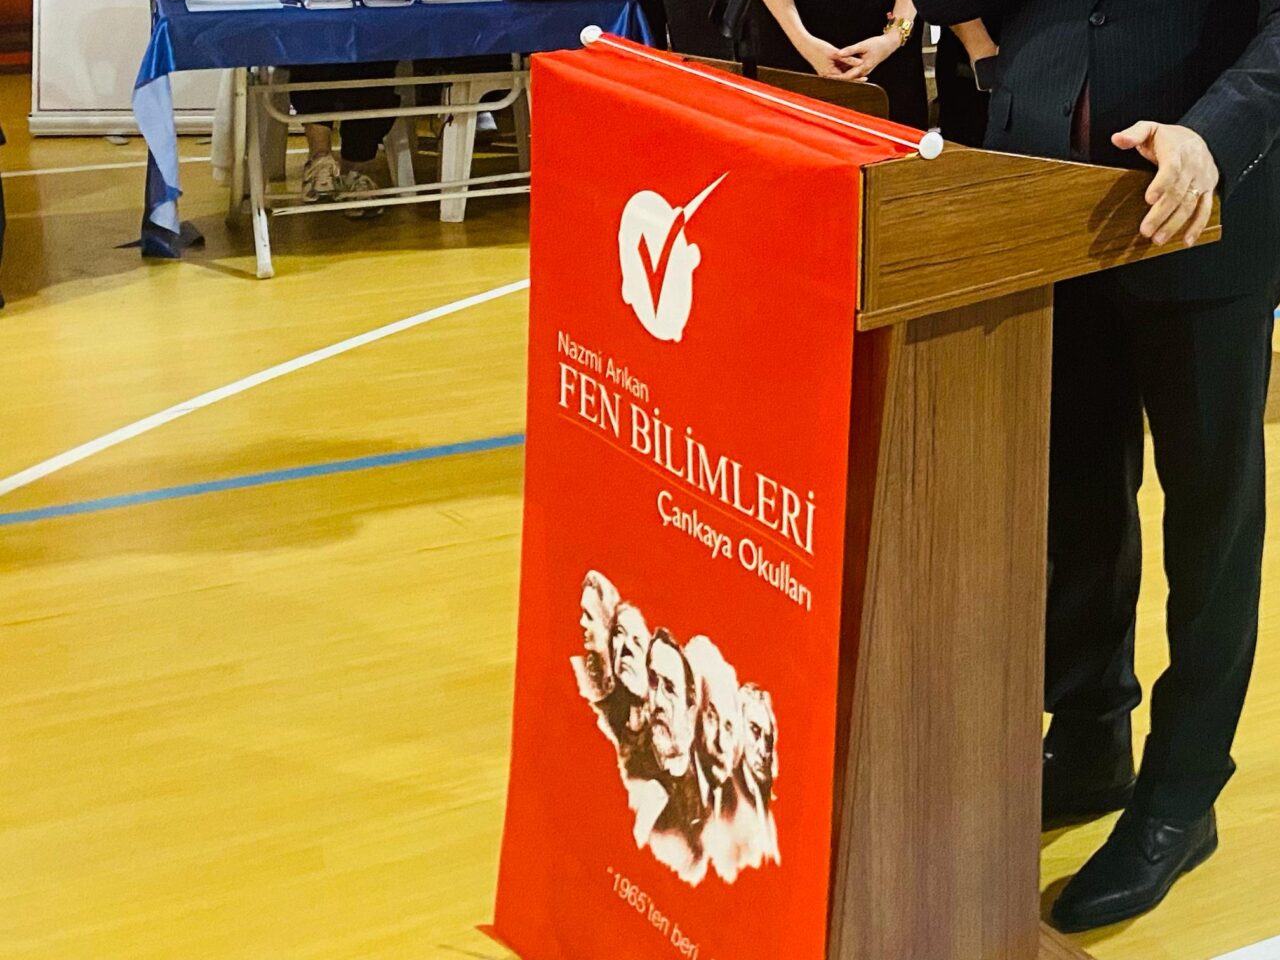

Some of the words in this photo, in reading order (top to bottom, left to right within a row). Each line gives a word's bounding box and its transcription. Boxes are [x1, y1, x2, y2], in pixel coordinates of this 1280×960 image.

[557, 330, 602, 374] Nazmi
[558, 361, 622, 439] FEN
[630, 406, 816, 556] BİLİMLERİ
[656, 490, 733, 559] Çankaya
[737, 537, 812, 612] Okulları
